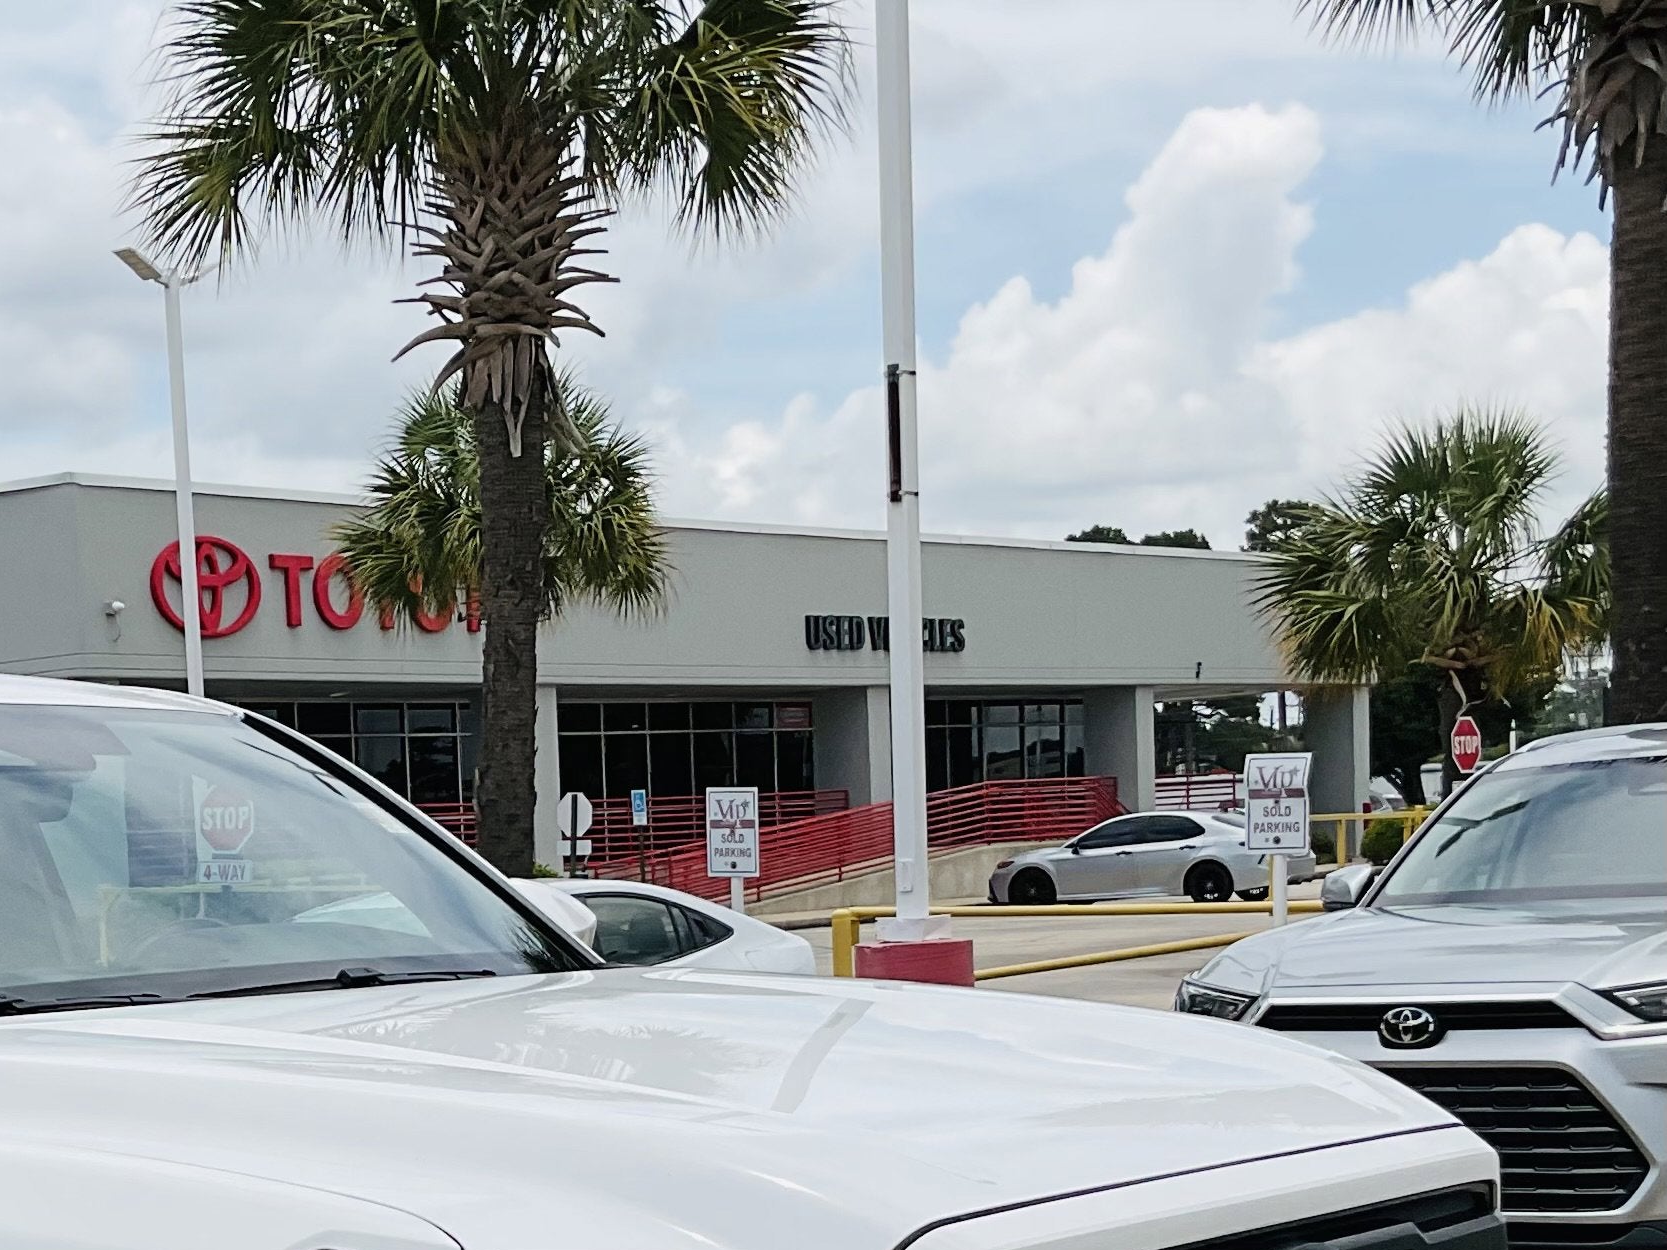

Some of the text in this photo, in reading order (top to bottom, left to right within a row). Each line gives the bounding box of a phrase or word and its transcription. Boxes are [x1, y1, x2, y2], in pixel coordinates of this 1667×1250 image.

[805, 615, 866, 651] USED
[1454, 735, 1479, 755] STOP
[202, 806, 250, 830] STOP
[1262, 805, 1292, 817] SOLD
[1253, 821, 1301, 834] PARKING
[721, 833, 745, 844] SOLD
[714, 847, 752, 858] PARKING
[203, 864, 246, 881] 4-WAY
